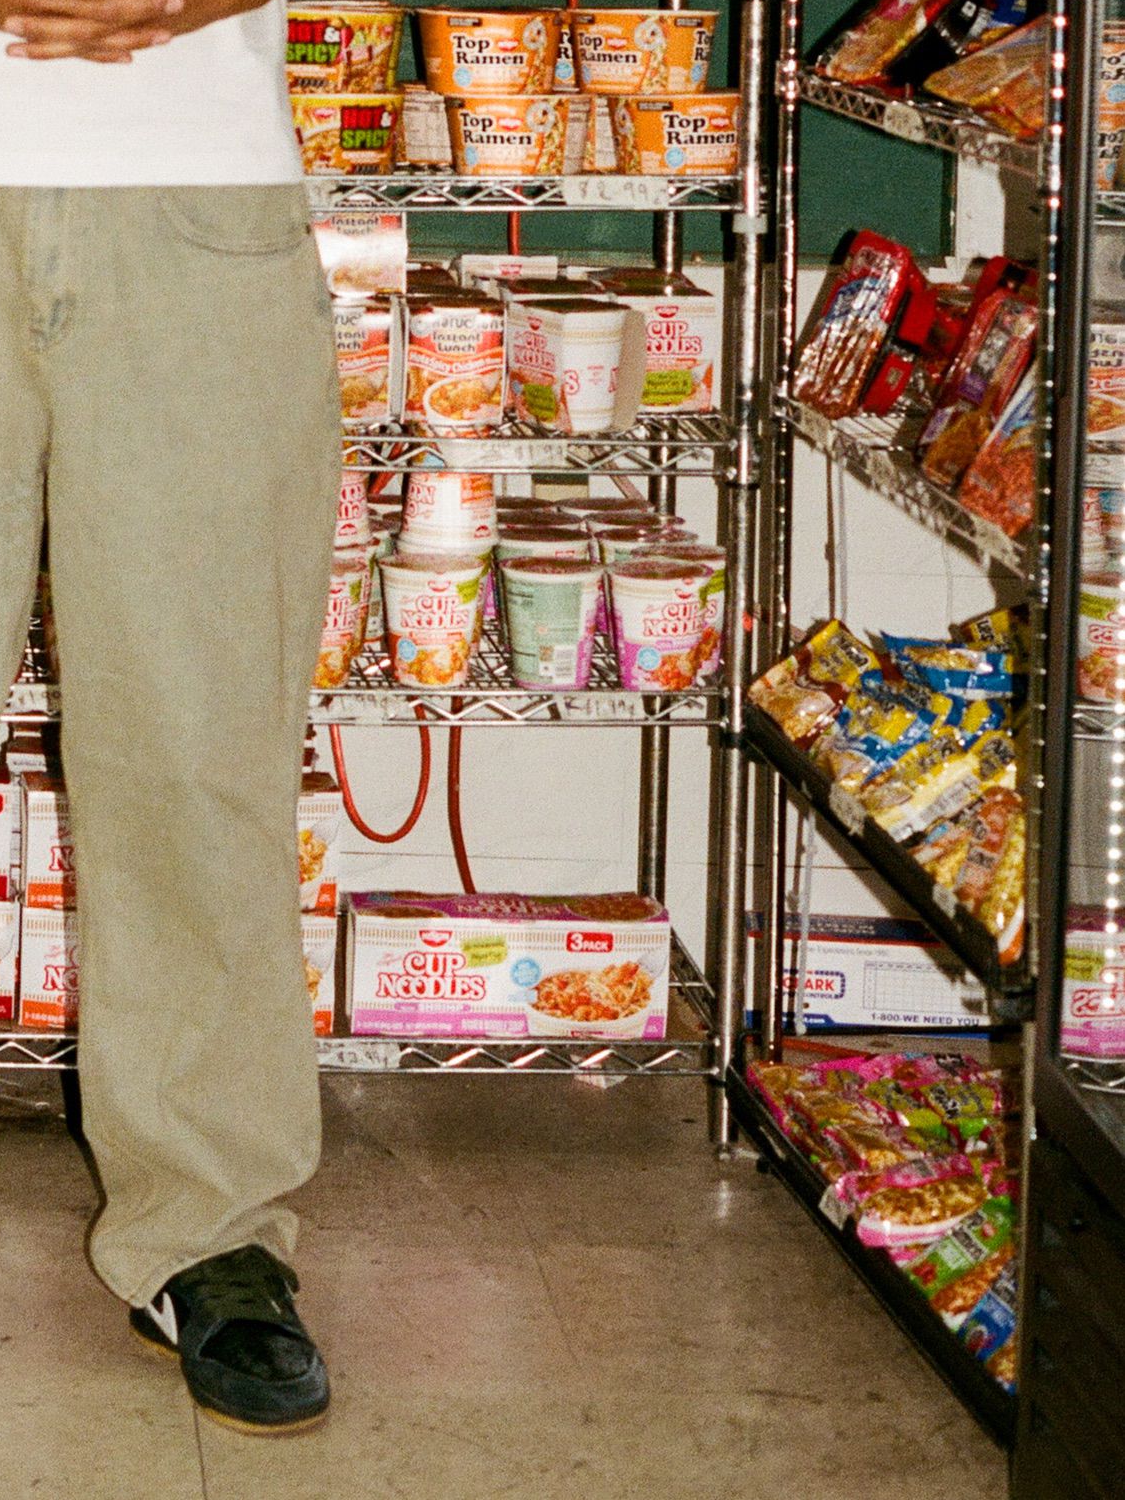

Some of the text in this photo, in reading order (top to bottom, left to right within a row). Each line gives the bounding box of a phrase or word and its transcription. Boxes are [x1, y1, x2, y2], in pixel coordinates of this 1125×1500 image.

[453, 35, 490, 53] Top
[578, 32, 603, 50] Top
[455, 51, 525, 66] Ramen
[579, 49, 638, 64] Ramen
[459, 112, 493, 132] Top
[663, 113, 706, 132] Top
[462, 129, 533, 146] Ramen
[665, 130, 737, 146] Ramen
[432, 333, 482, 343] Instant
[646, 320, 688, 339] CUP
[437, 342, 477, 354] Lunch
[327, 597, 352, 616] UP
[416, 595, 459, 614] CUP
[400, 609, 470, 629] NOODLES
[570, 932, 609, 951] 3 PACK
[402, 952, 466, 977] CUP
[377, 973, 485, 1000] NOODLES
[923, 1014, 953, 1025] NEED
